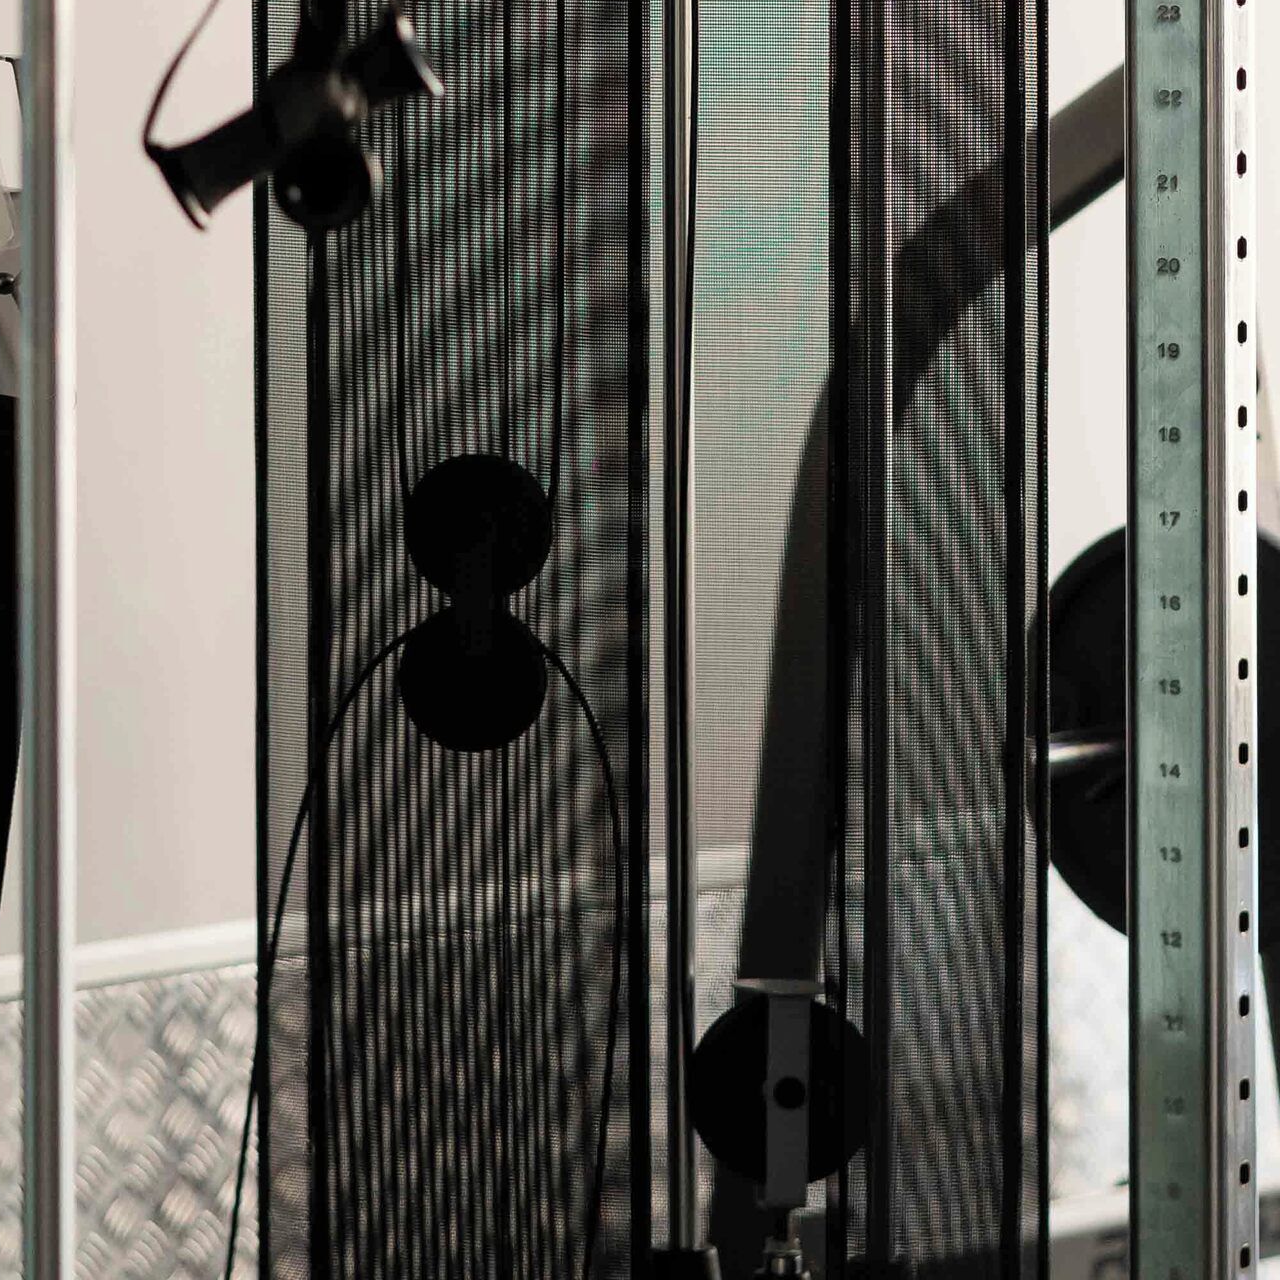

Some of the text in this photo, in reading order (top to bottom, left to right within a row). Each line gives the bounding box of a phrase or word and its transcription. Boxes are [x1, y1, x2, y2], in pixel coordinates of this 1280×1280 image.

[1156, 5, 1181, 22] 23
[1158, 89, 1182, 106] 22
[1157, 174, 1178, 191] 21
[1157, 258, 1180, 275] 20
[1158, 342, 1180, 359] 19
[1159, 426, 1181, 443] 18
[1160, 511, 1180, 527] 17
[1160, 595, 1181, 611] 16
[1159, 679, 1181, 695] 15
[1160, 763, 1180, 779] 14
[1160, 847, 1181, 863] 13
[1160, 931, 1182, 948] 12
